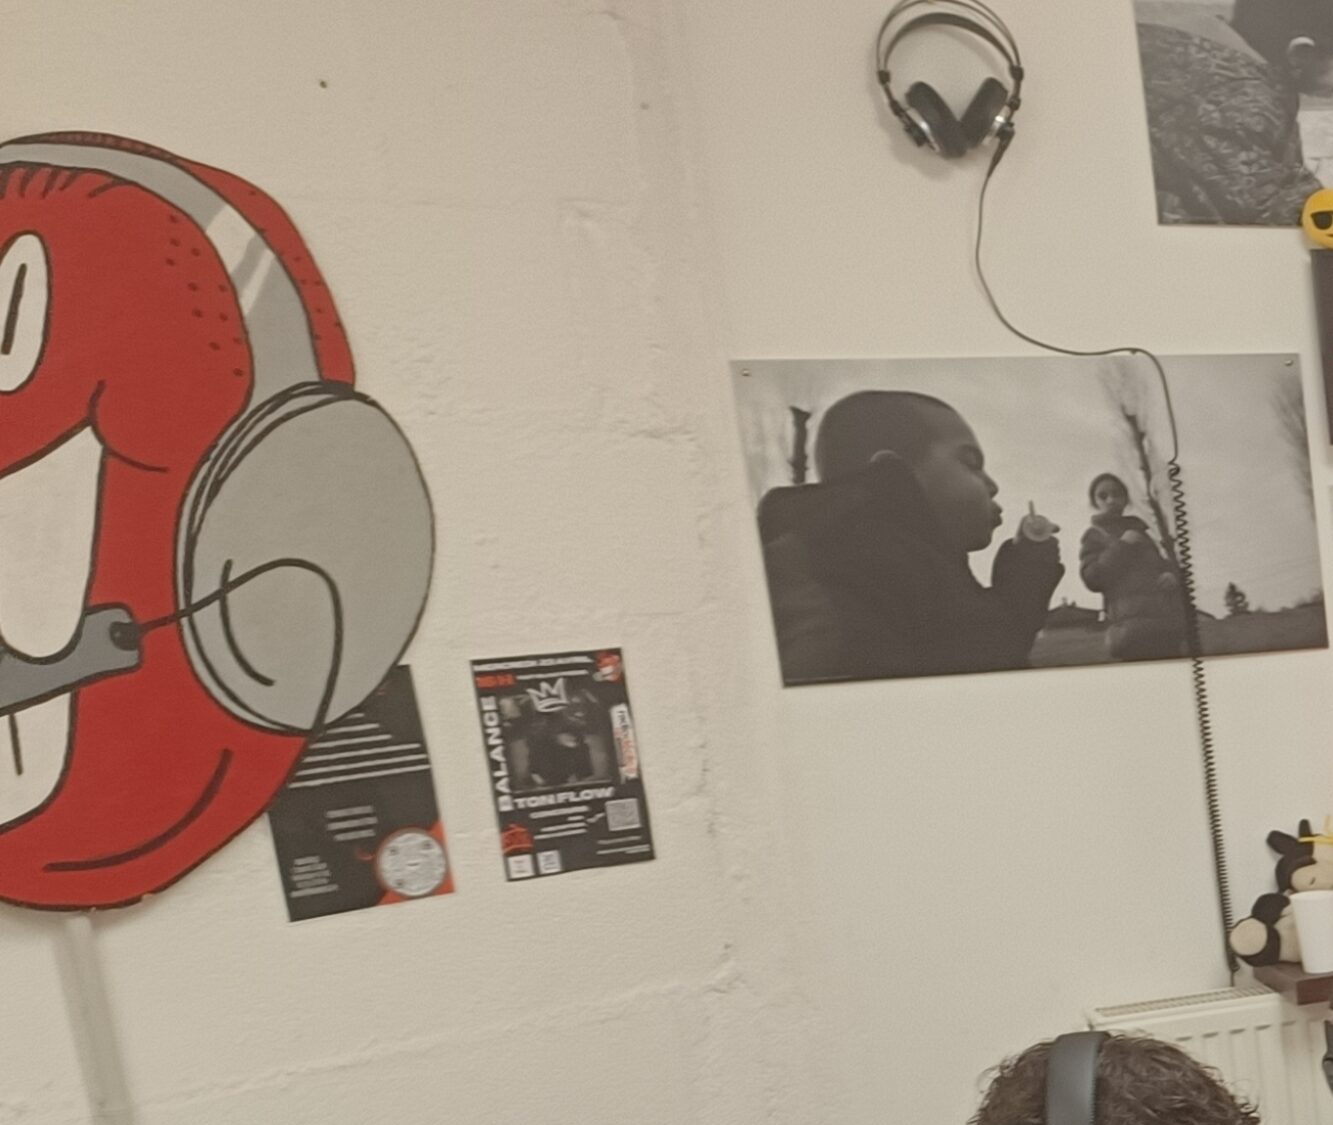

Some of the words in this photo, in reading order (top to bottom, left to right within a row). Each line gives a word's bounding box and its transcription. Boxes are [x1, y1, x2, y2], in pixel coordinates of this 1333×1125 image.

[479, 695, 514, 812] BALANCE
[514, 793, 555, 810] TON
[557, 786, 616, 804] FLOW
